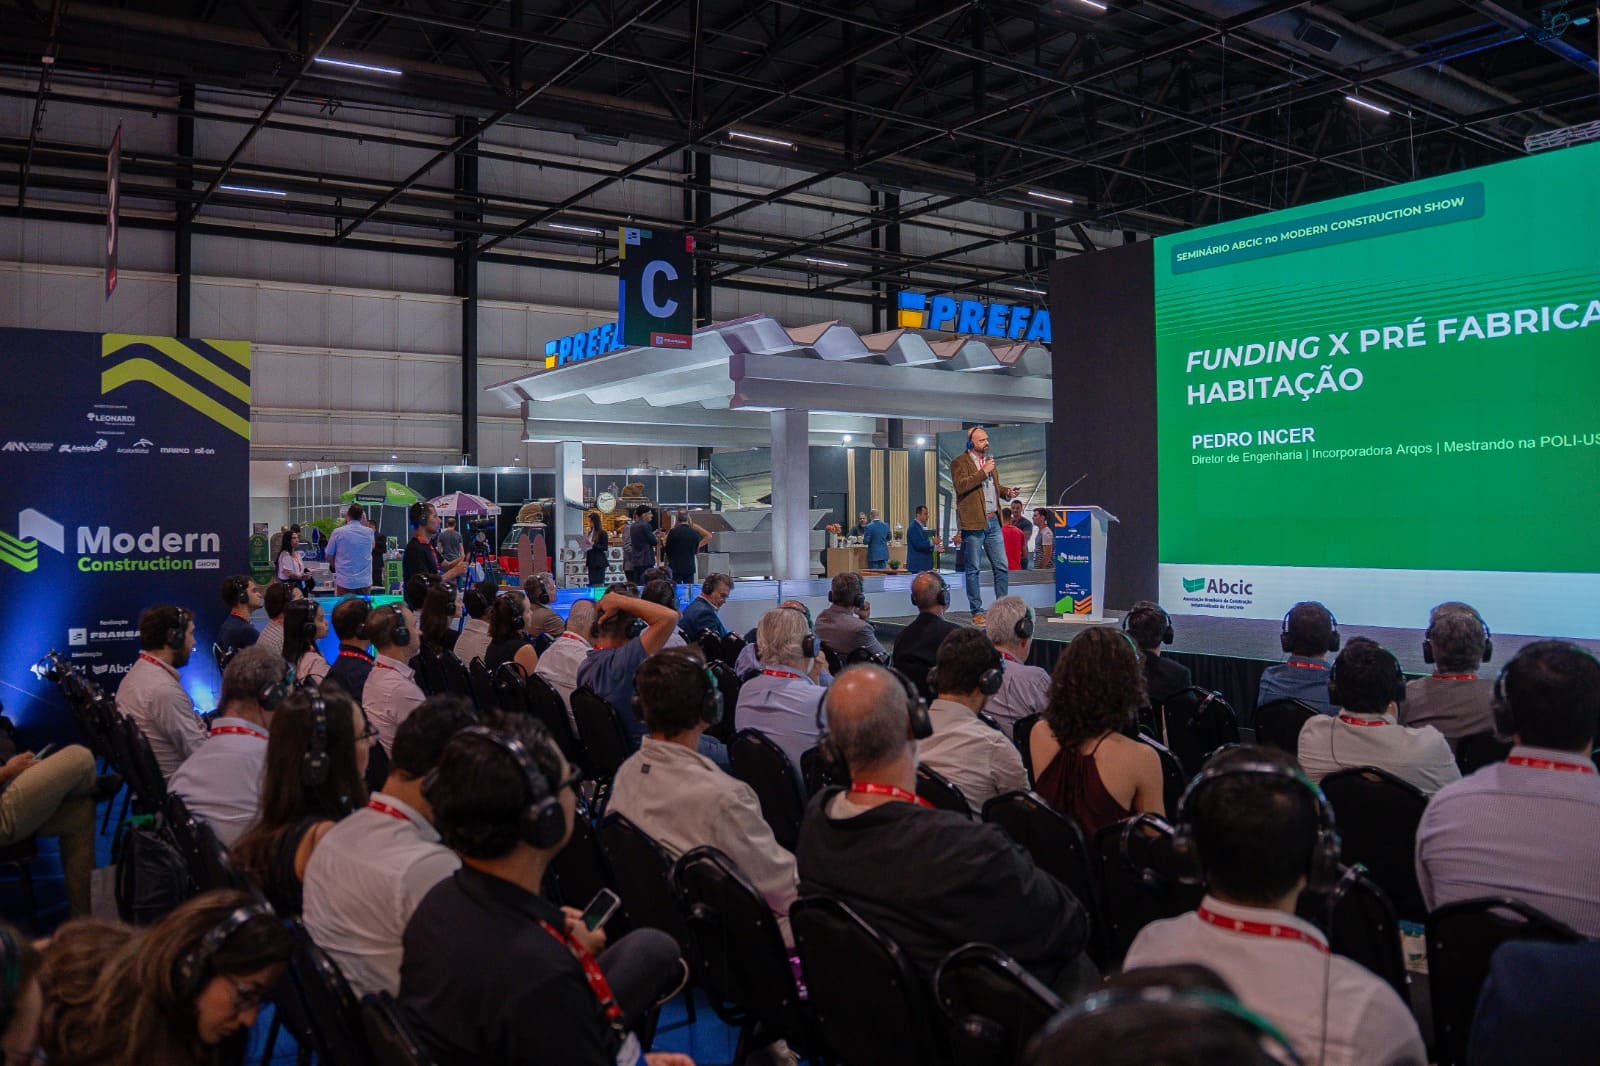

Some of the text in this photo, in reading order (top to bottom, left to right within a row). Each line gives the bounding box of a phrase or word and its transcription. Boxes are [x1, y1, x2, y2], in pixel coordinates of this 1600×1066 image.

[1176, 197, 1465, 262] SEMINÁRIO ABCIC no MODERN CONSTRUCTION SHOW
[641, 260, 679, 318] C
[927, 295, 1052, 343] PREFA
[1185, 299, 1600, 373] FUNDING X PRÉ FABRICA
[1187, 364, 1364, 406] HABITAÇÃO
[1191, 427, 1316, 450] PEDRO INCER
[1191, 454, 1225, 465] Diretor
[1226, 453, 1240, 464] de
[1242, 450, 1303, 464] Engenharia
[1312, 445, 1393, 461] Incorporadora
[1396, 443, 1432, 457] Arqos
[1443, 438, 1514, 453] Mestrando
[1518, 438, 1536, 449] na
[77, 526, 220, 554] Modern
[77, 556, 193, 572] Construction
[1206, 578, 1253, 595] Abcic
